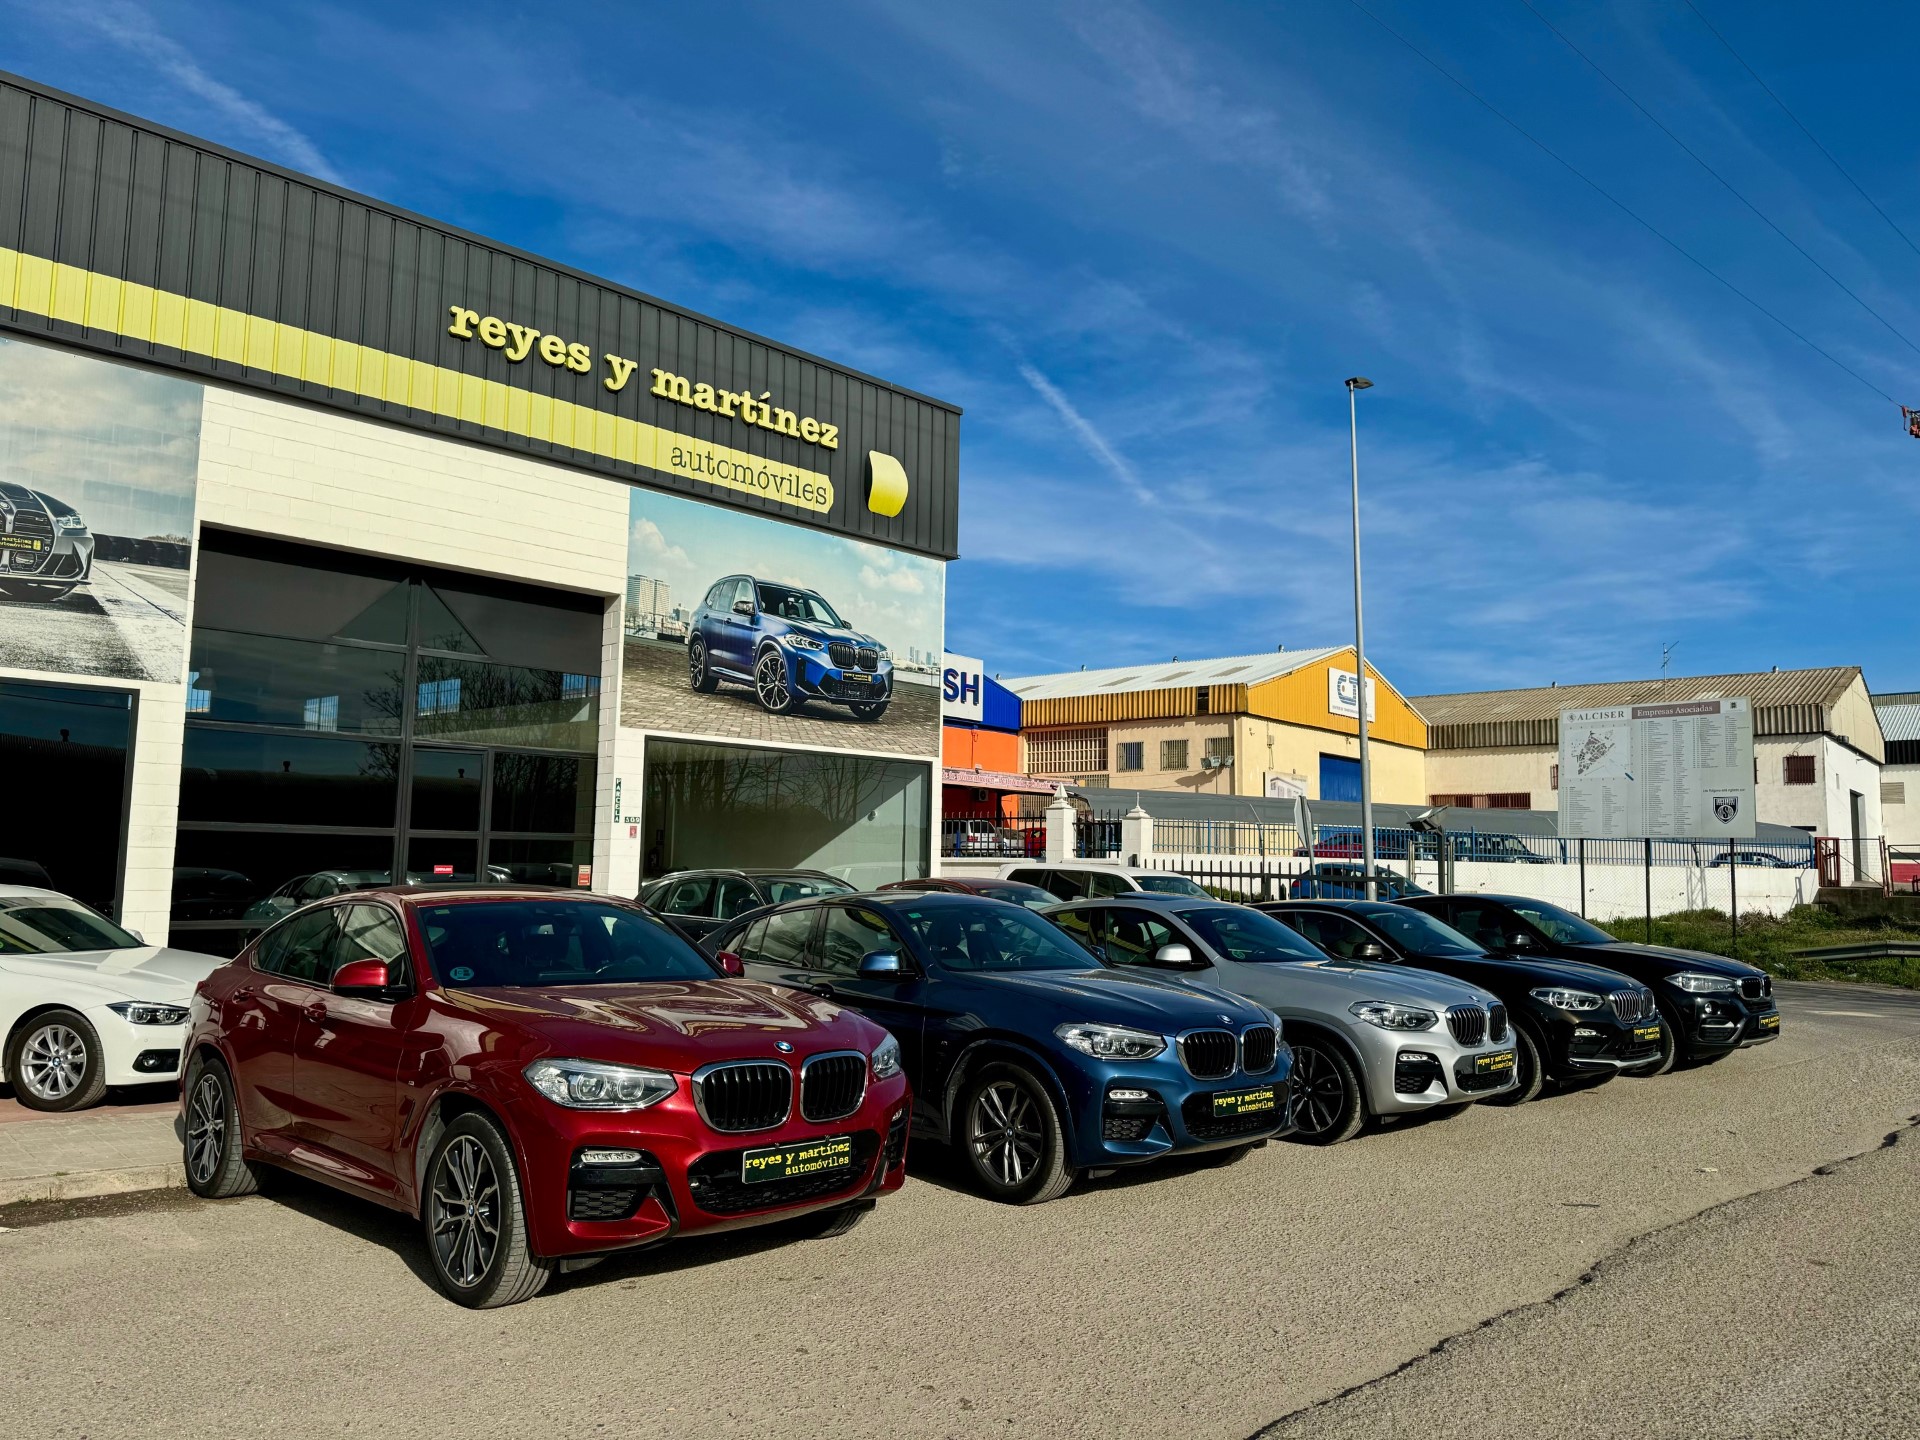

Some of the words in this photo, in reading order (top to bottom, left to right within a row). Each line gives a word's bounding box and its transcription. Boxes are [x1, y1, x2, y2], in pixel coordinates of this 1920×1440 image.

[449, 305, 592, 374] reyes
[604, 353, 638, 392] y
[651, 367, 839, 449] martínez
[671, 446, 828, 506] automóviles
[1577, 710, 1625, 721] ALCISER
[1637, 707, 1674, 718] Empresas
[1675, 704, 1713, 715] Asociadas
[1214, 1096, 1235, 1107] reyes
[1237, 1096, 1242, 1105] y
[1244, 1090, 1274, 1102] martínez
[1237, 1101, 1274, 1112] automóviles
[745, 1154, 782, 1169] reyes
[786, 1152, 795, 1165] y
[798, 1142, 850, 1160] martínez
[785, 1156, 849, 1175] automóviles
